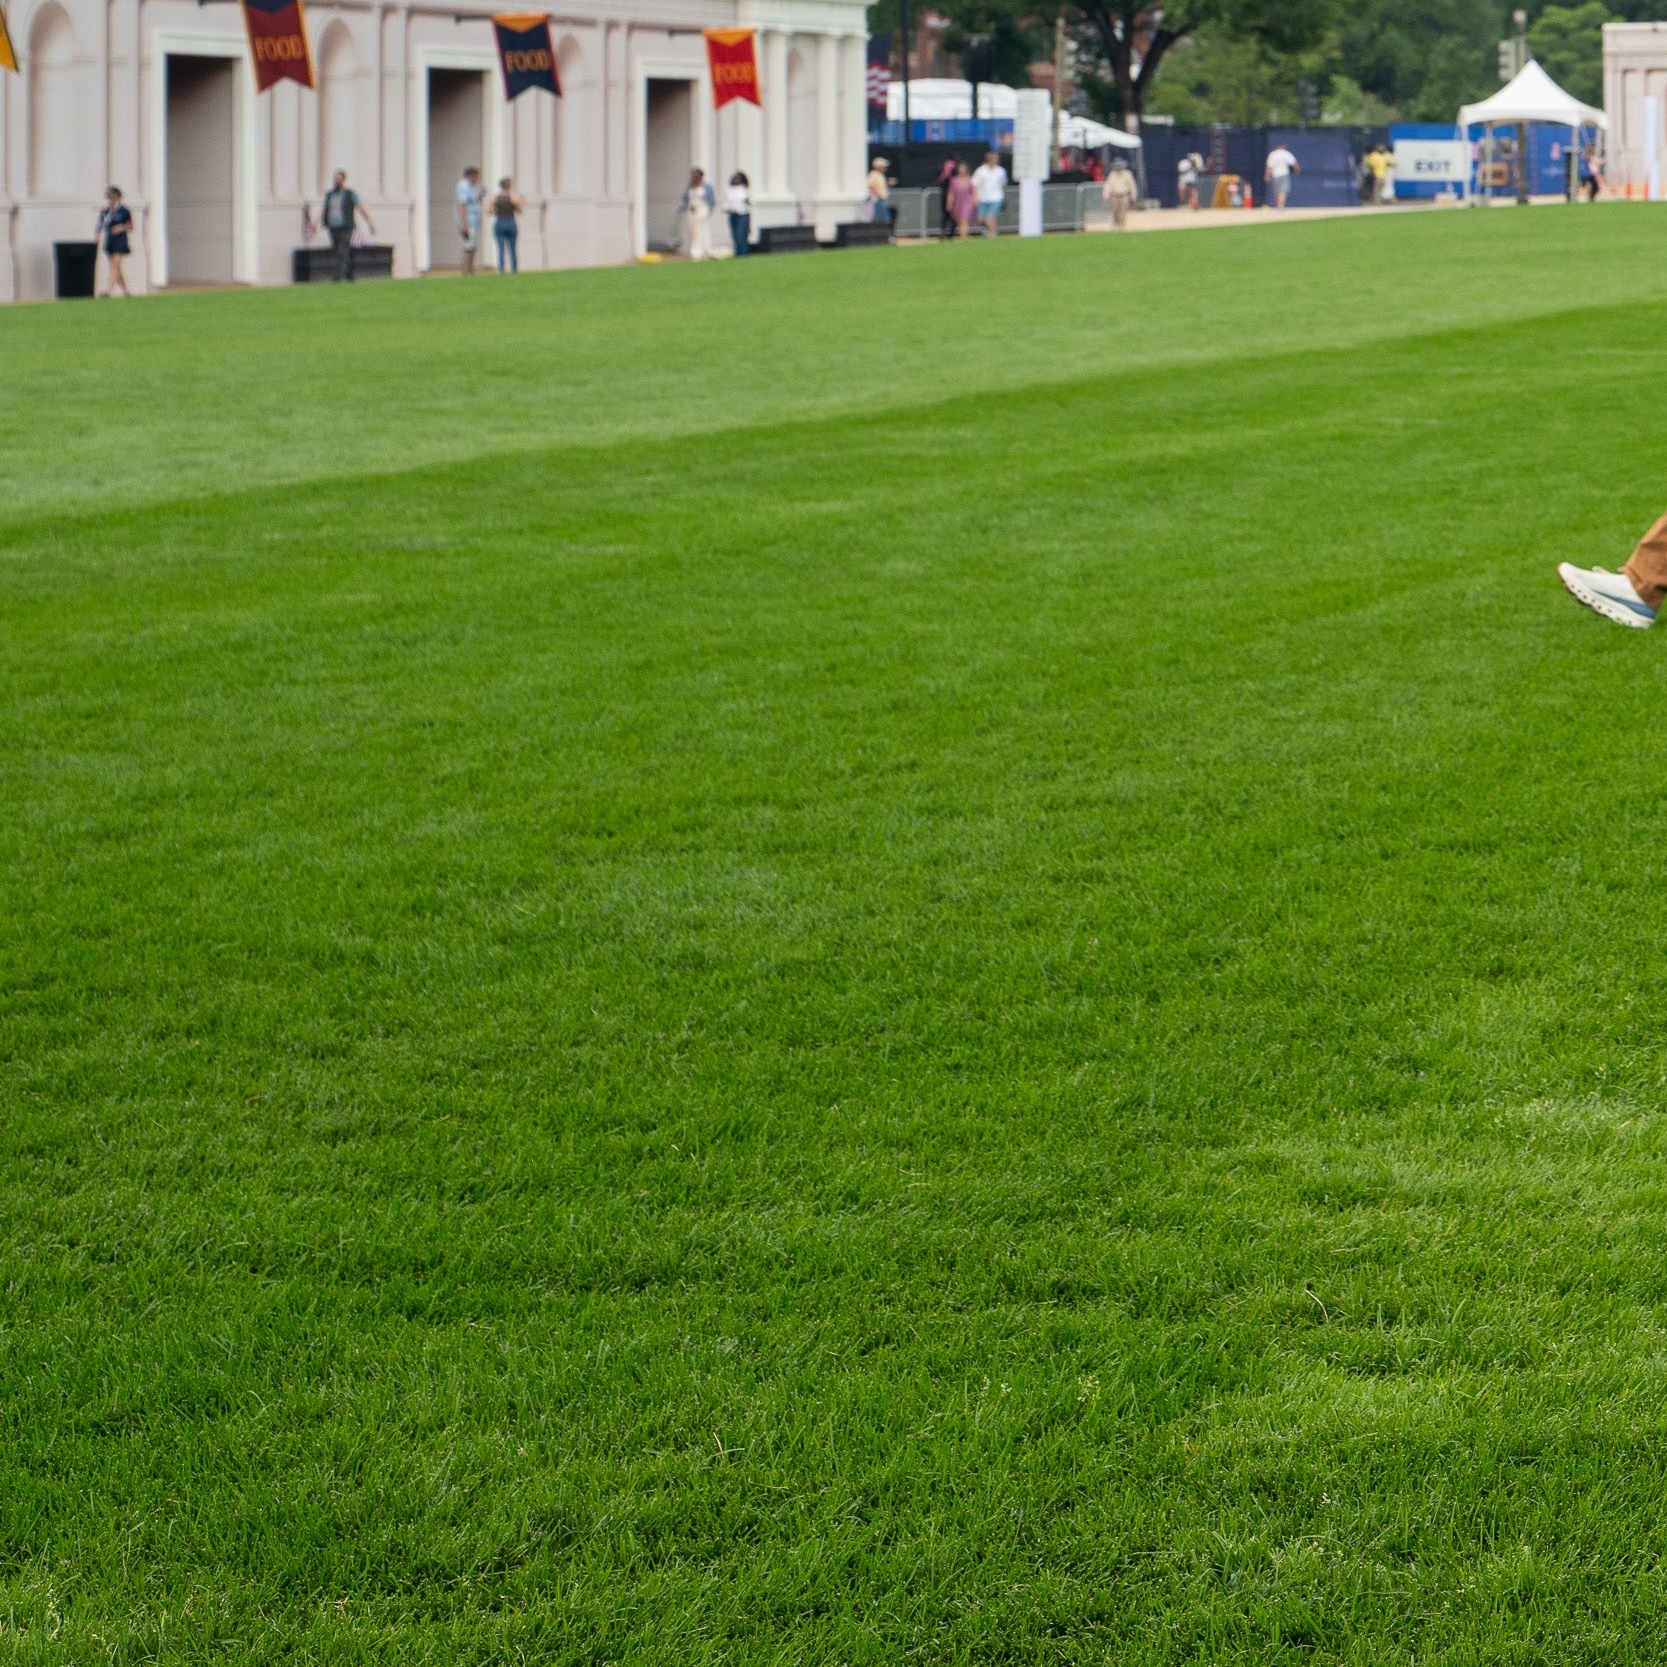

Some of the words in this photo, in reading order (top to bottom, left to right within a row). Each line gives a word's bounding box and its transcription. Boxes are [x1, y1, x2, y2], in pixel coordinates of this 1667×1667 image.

[254, 35, 304, 62] FOOD
[505, 48, 550, 73] FOOD
[713, 62, 755, 85] FOOD
[1415, 160, 1450, 172] EXIT
